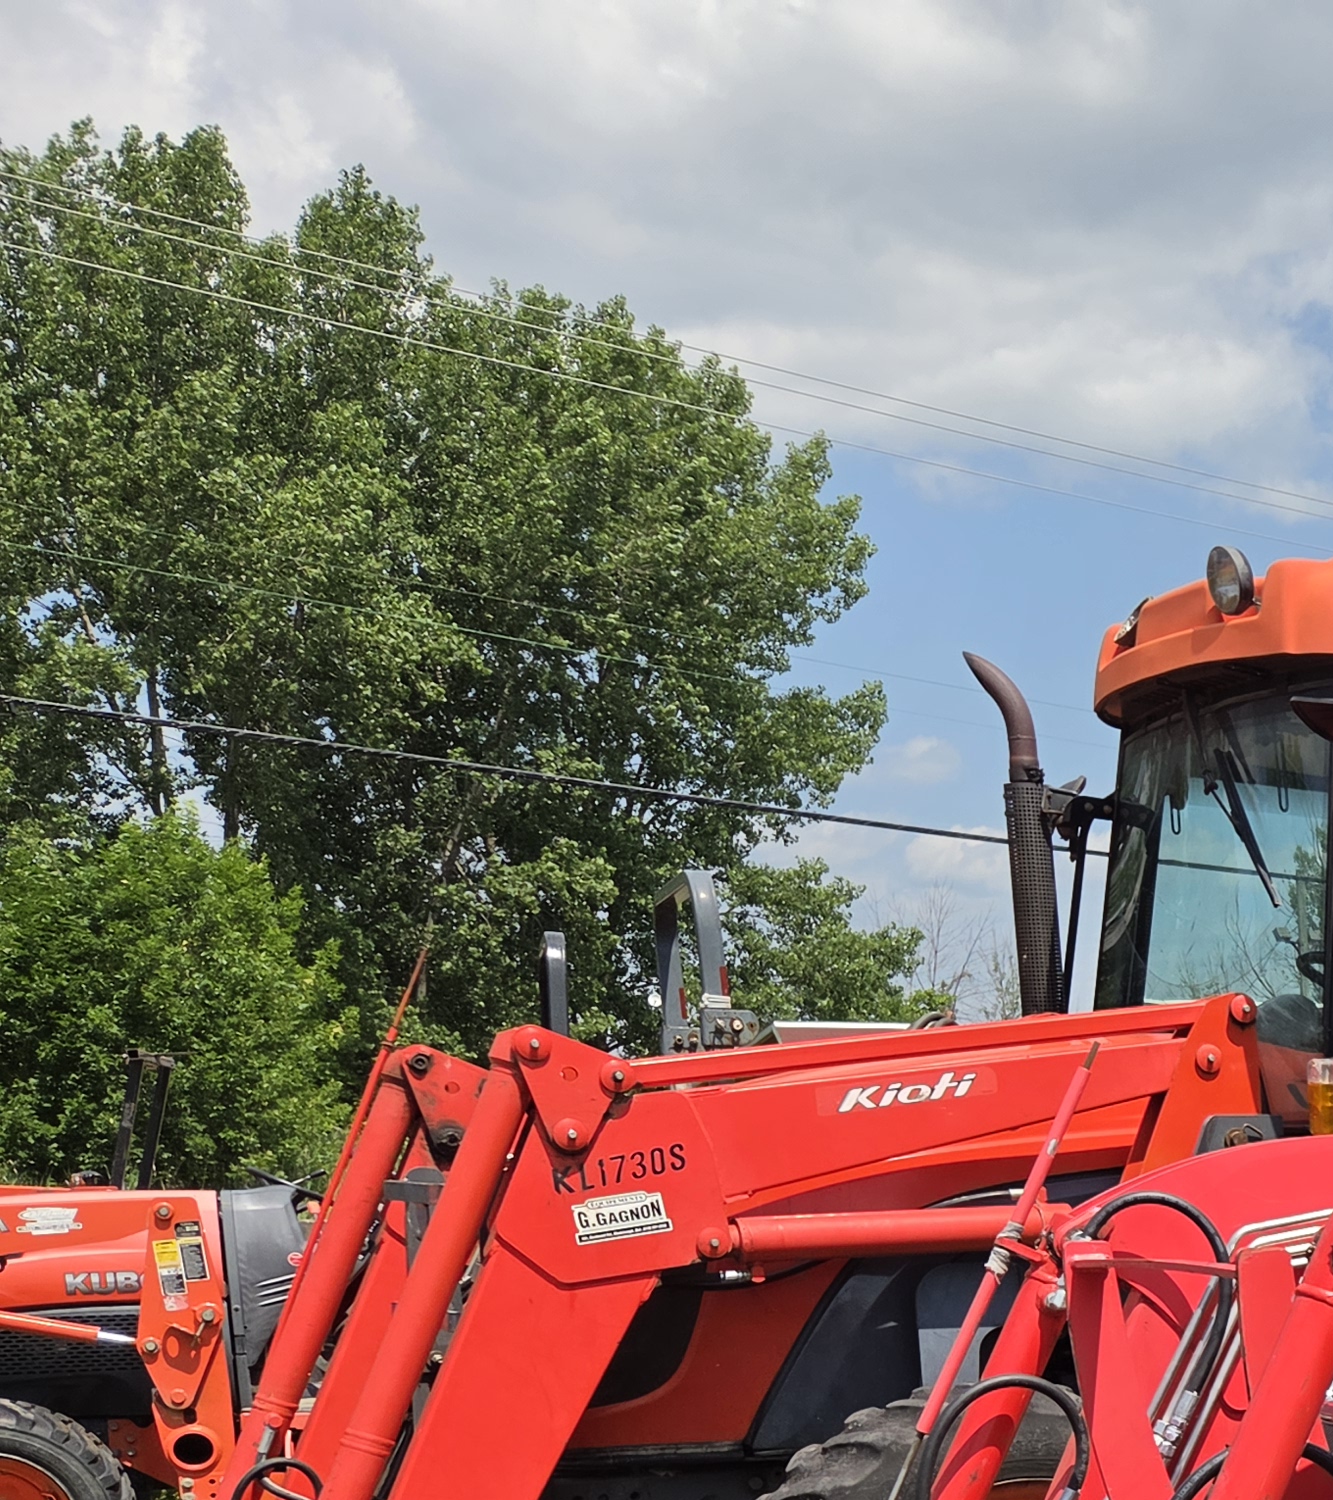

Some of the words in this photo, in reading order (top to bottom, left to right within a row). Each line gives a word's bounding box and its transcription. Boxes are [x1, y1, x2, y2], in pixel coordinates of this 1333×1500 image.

[838, 1071, 977, 1113] Kioti
[577, 1199, 662, 1229] G.GAGNON
[65, 1271, 145, 1296] KUB
